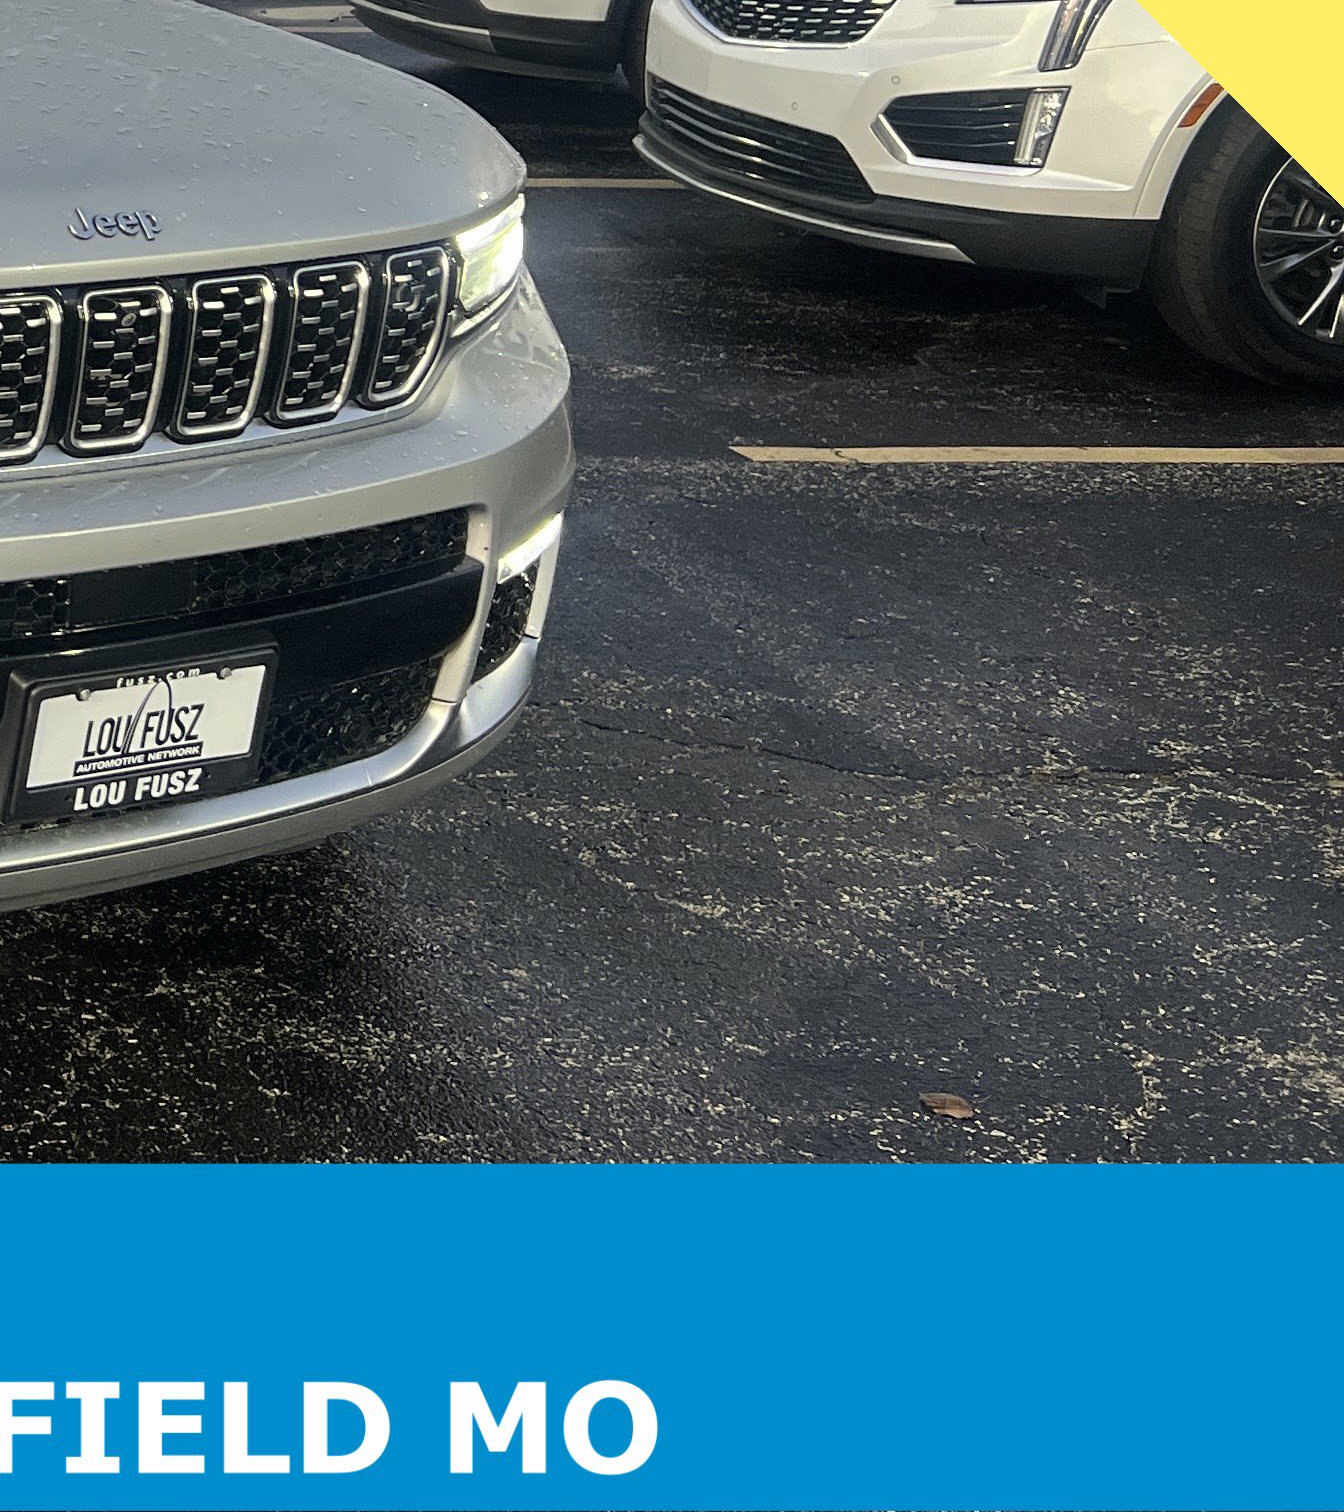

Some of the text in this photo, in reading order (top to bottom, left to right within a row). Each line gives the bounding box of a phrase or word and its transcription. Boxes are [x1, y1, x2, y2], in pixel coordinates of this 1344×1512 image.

[67, 207, 162, 242] Jeep
[82, 703, 205, 758] LOU FUSZ
[76, 744, 201, 774] AUTOMOTIVE NETWORK
[73, 767, 203, 811] LOU FUSZ
